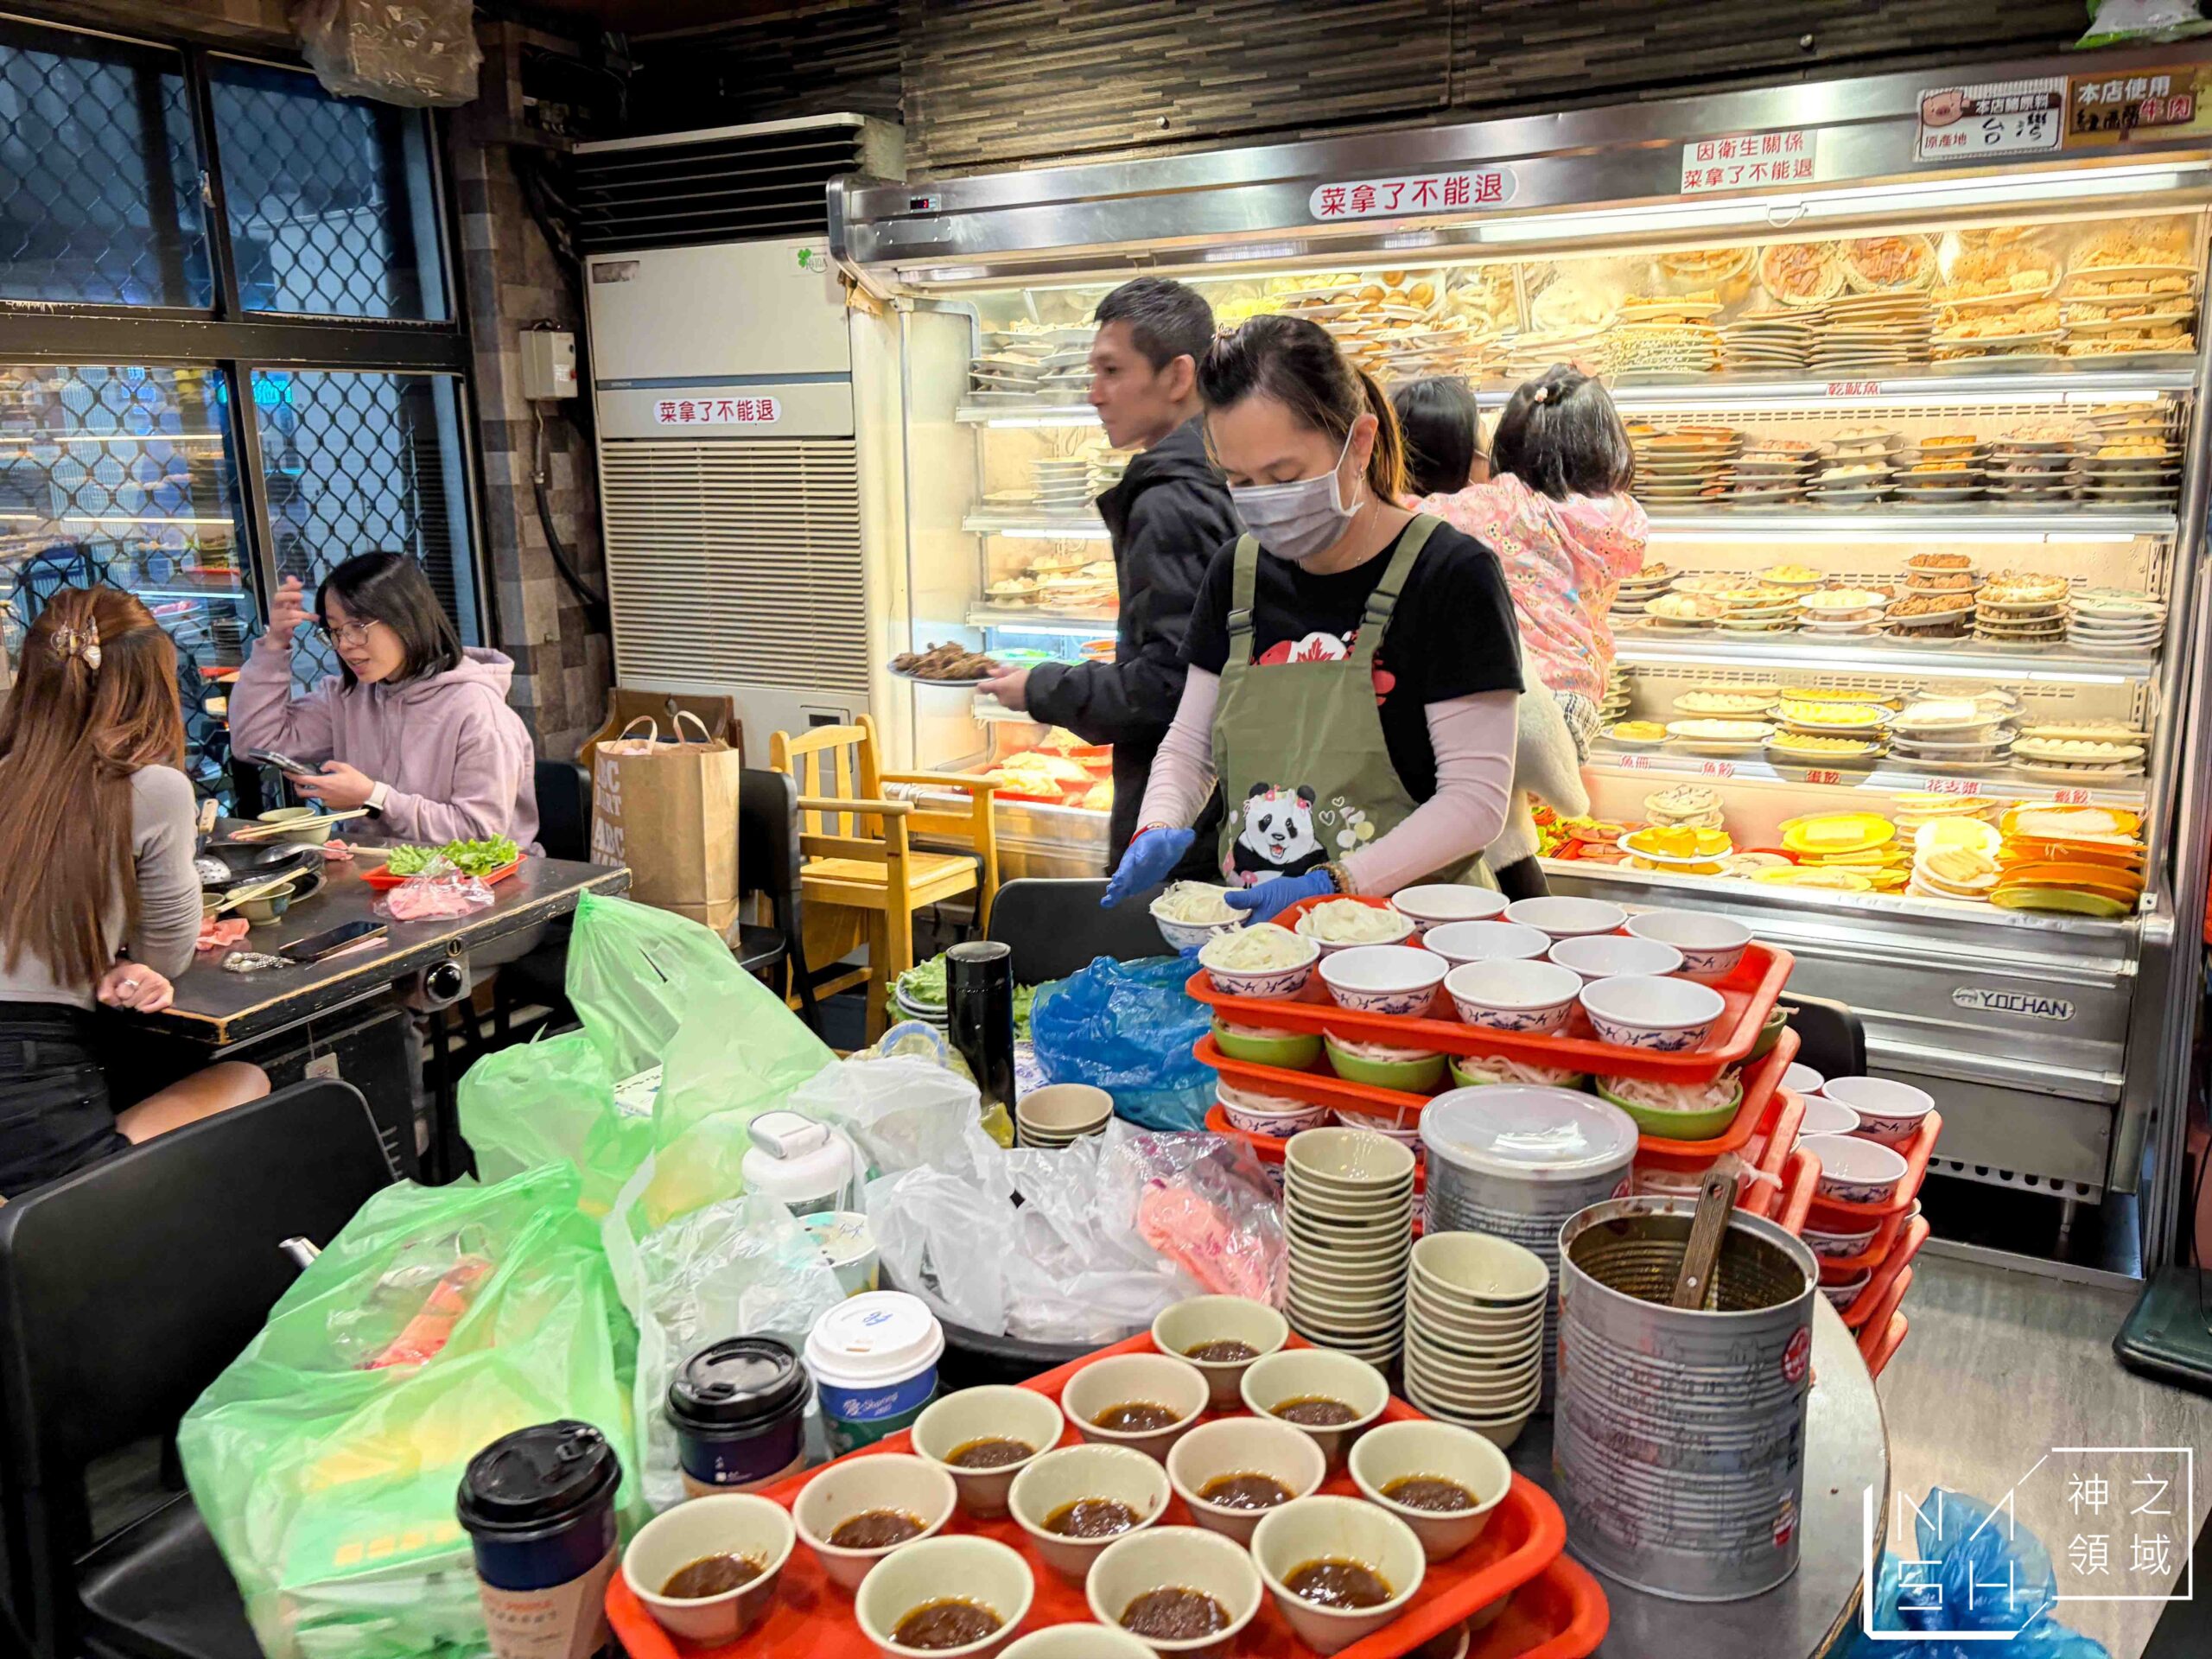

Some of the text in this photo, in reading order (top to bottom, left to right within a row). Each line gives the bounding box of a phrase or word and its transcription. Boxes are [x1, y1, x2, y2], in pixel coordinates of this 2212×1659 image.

[2077, 75, 2171, 105] 本店使用
[2139, 95, 2192, 122] 牛肉
[1696, 131, 1803, 162] 因衛生關係
[1925, 132, 1967, 149] 原產地
[1683, 157, 1813, 189] 菜拿了不能退
[1320, 173, 1503, 215] 菜拿了不能退
[659, 399, 775, 423] 菜拿了不能退
[594, 817, 626, 858] ABC
[1980, 992, 2067, 1018] YOCHAN
